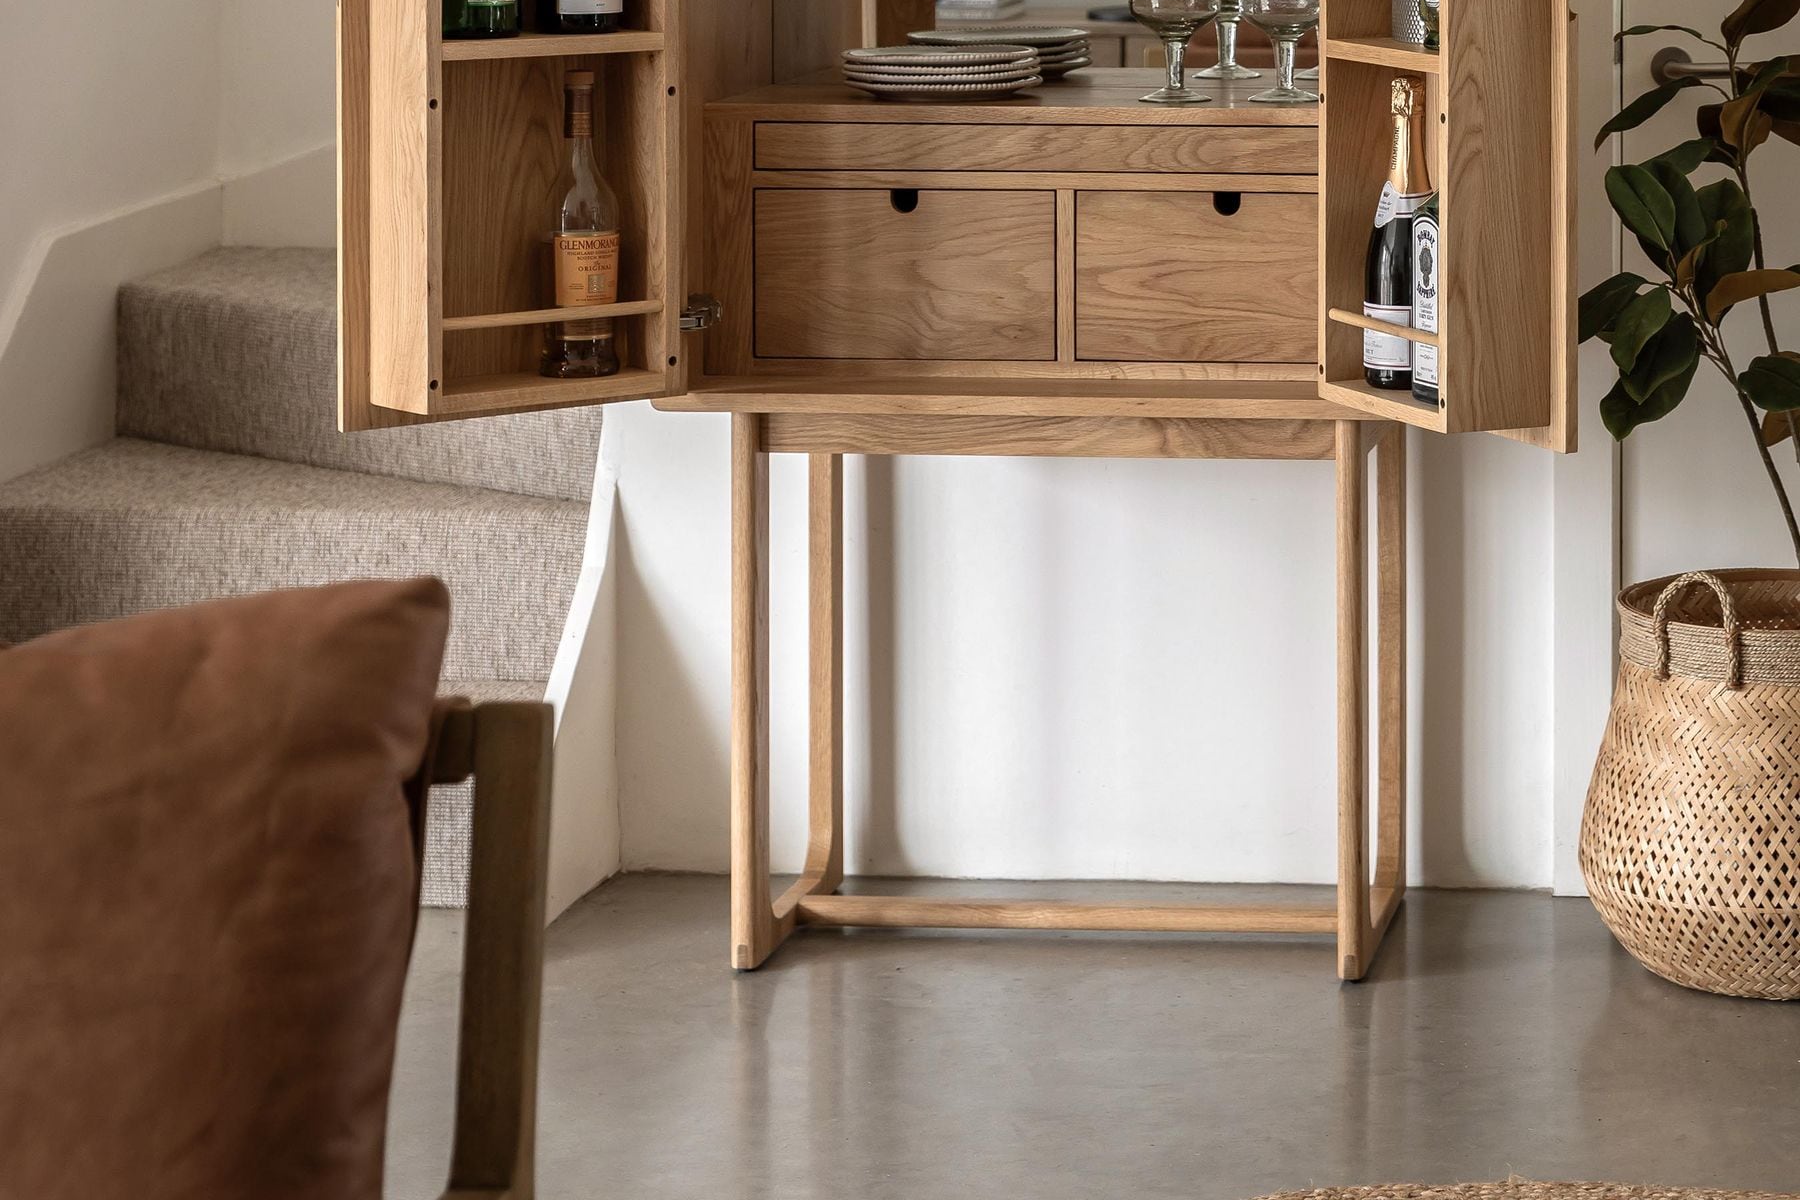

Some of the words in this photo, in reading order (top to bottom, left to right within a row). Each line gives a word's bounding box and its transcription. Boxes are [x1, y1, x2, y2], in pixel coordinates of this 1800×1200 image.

[1391, 125, 1401, 171] CHAMPAGNE
[1417, 230, 1436, 248] BOMBAY
[1417, 280, 1436, 299] SAPPHIRE
